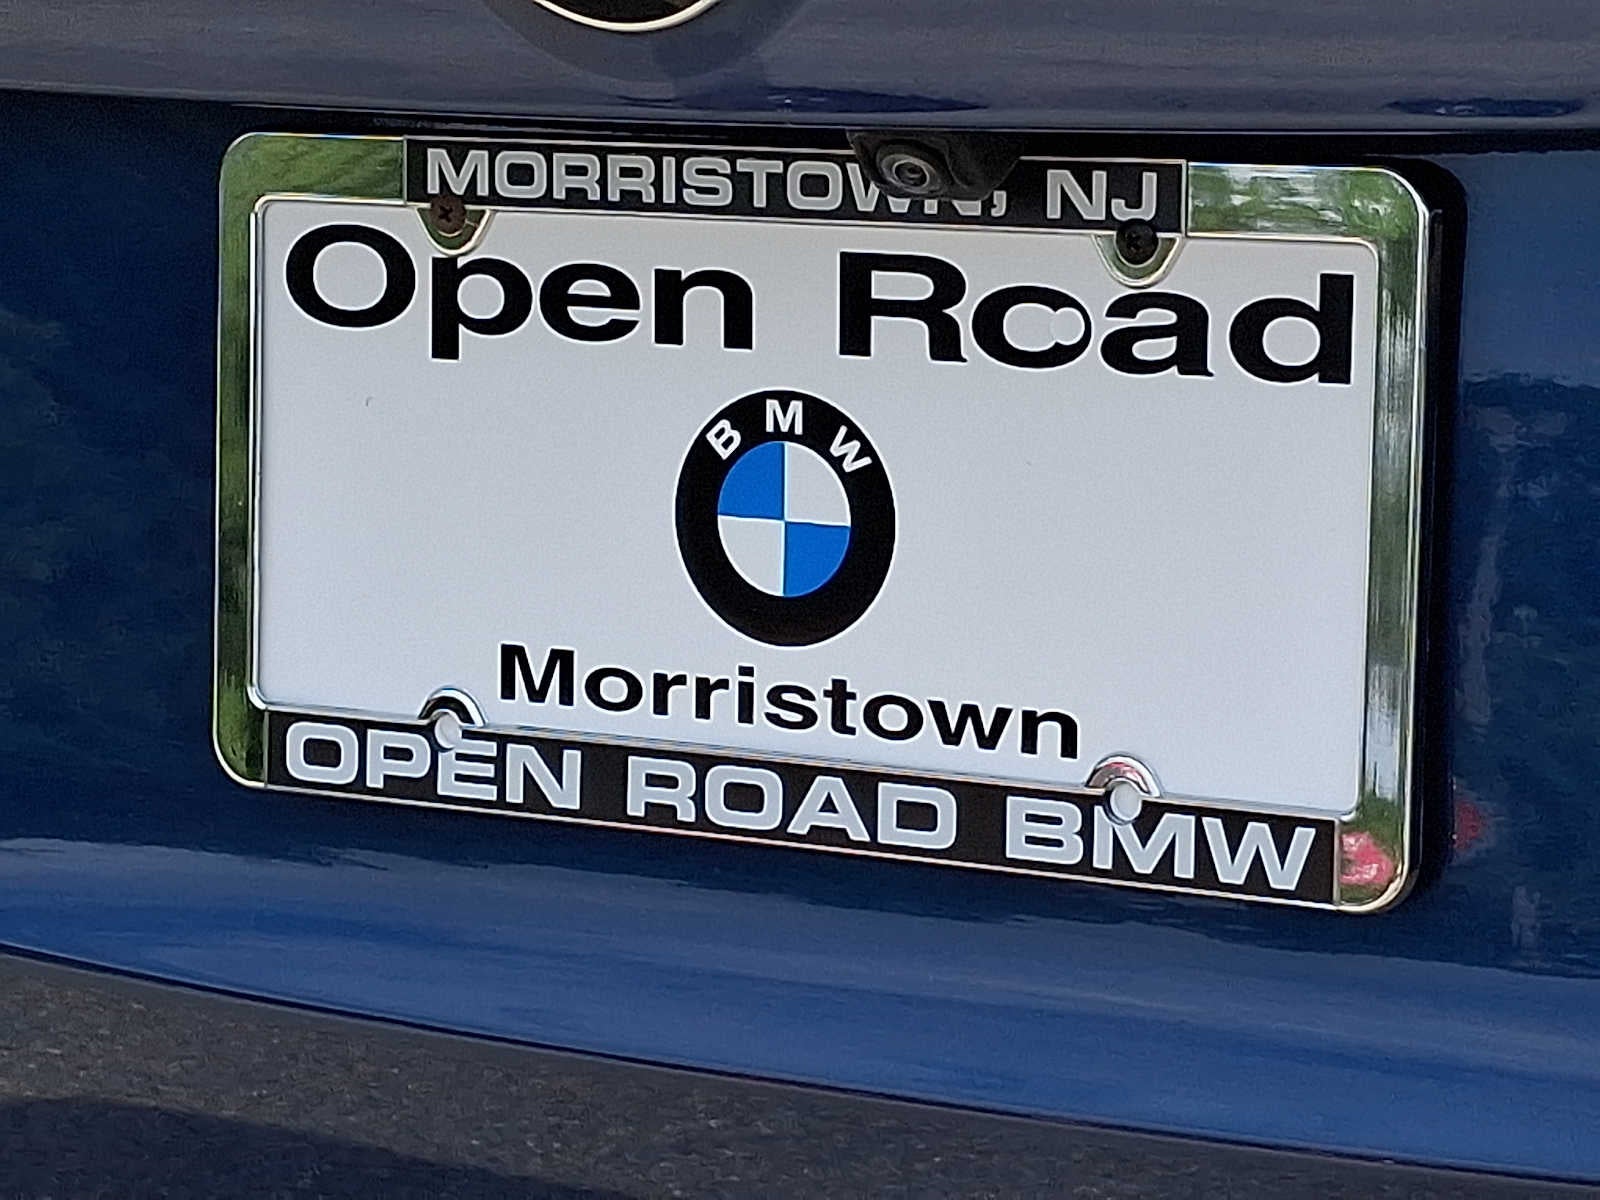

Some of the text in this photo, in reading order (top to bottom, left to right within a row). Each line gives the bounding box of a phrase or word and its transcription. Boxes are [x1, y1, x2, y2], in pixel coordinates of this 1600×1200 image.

[1046, 169, 1158, 221] NJ
[286, 224, 1354, 384] Open Road
[705, 399, 873, 473] BMW
[500, 644, 1078, 758] Morristown
[285, 722, 1317, 892] OPEN ROAD BMW
